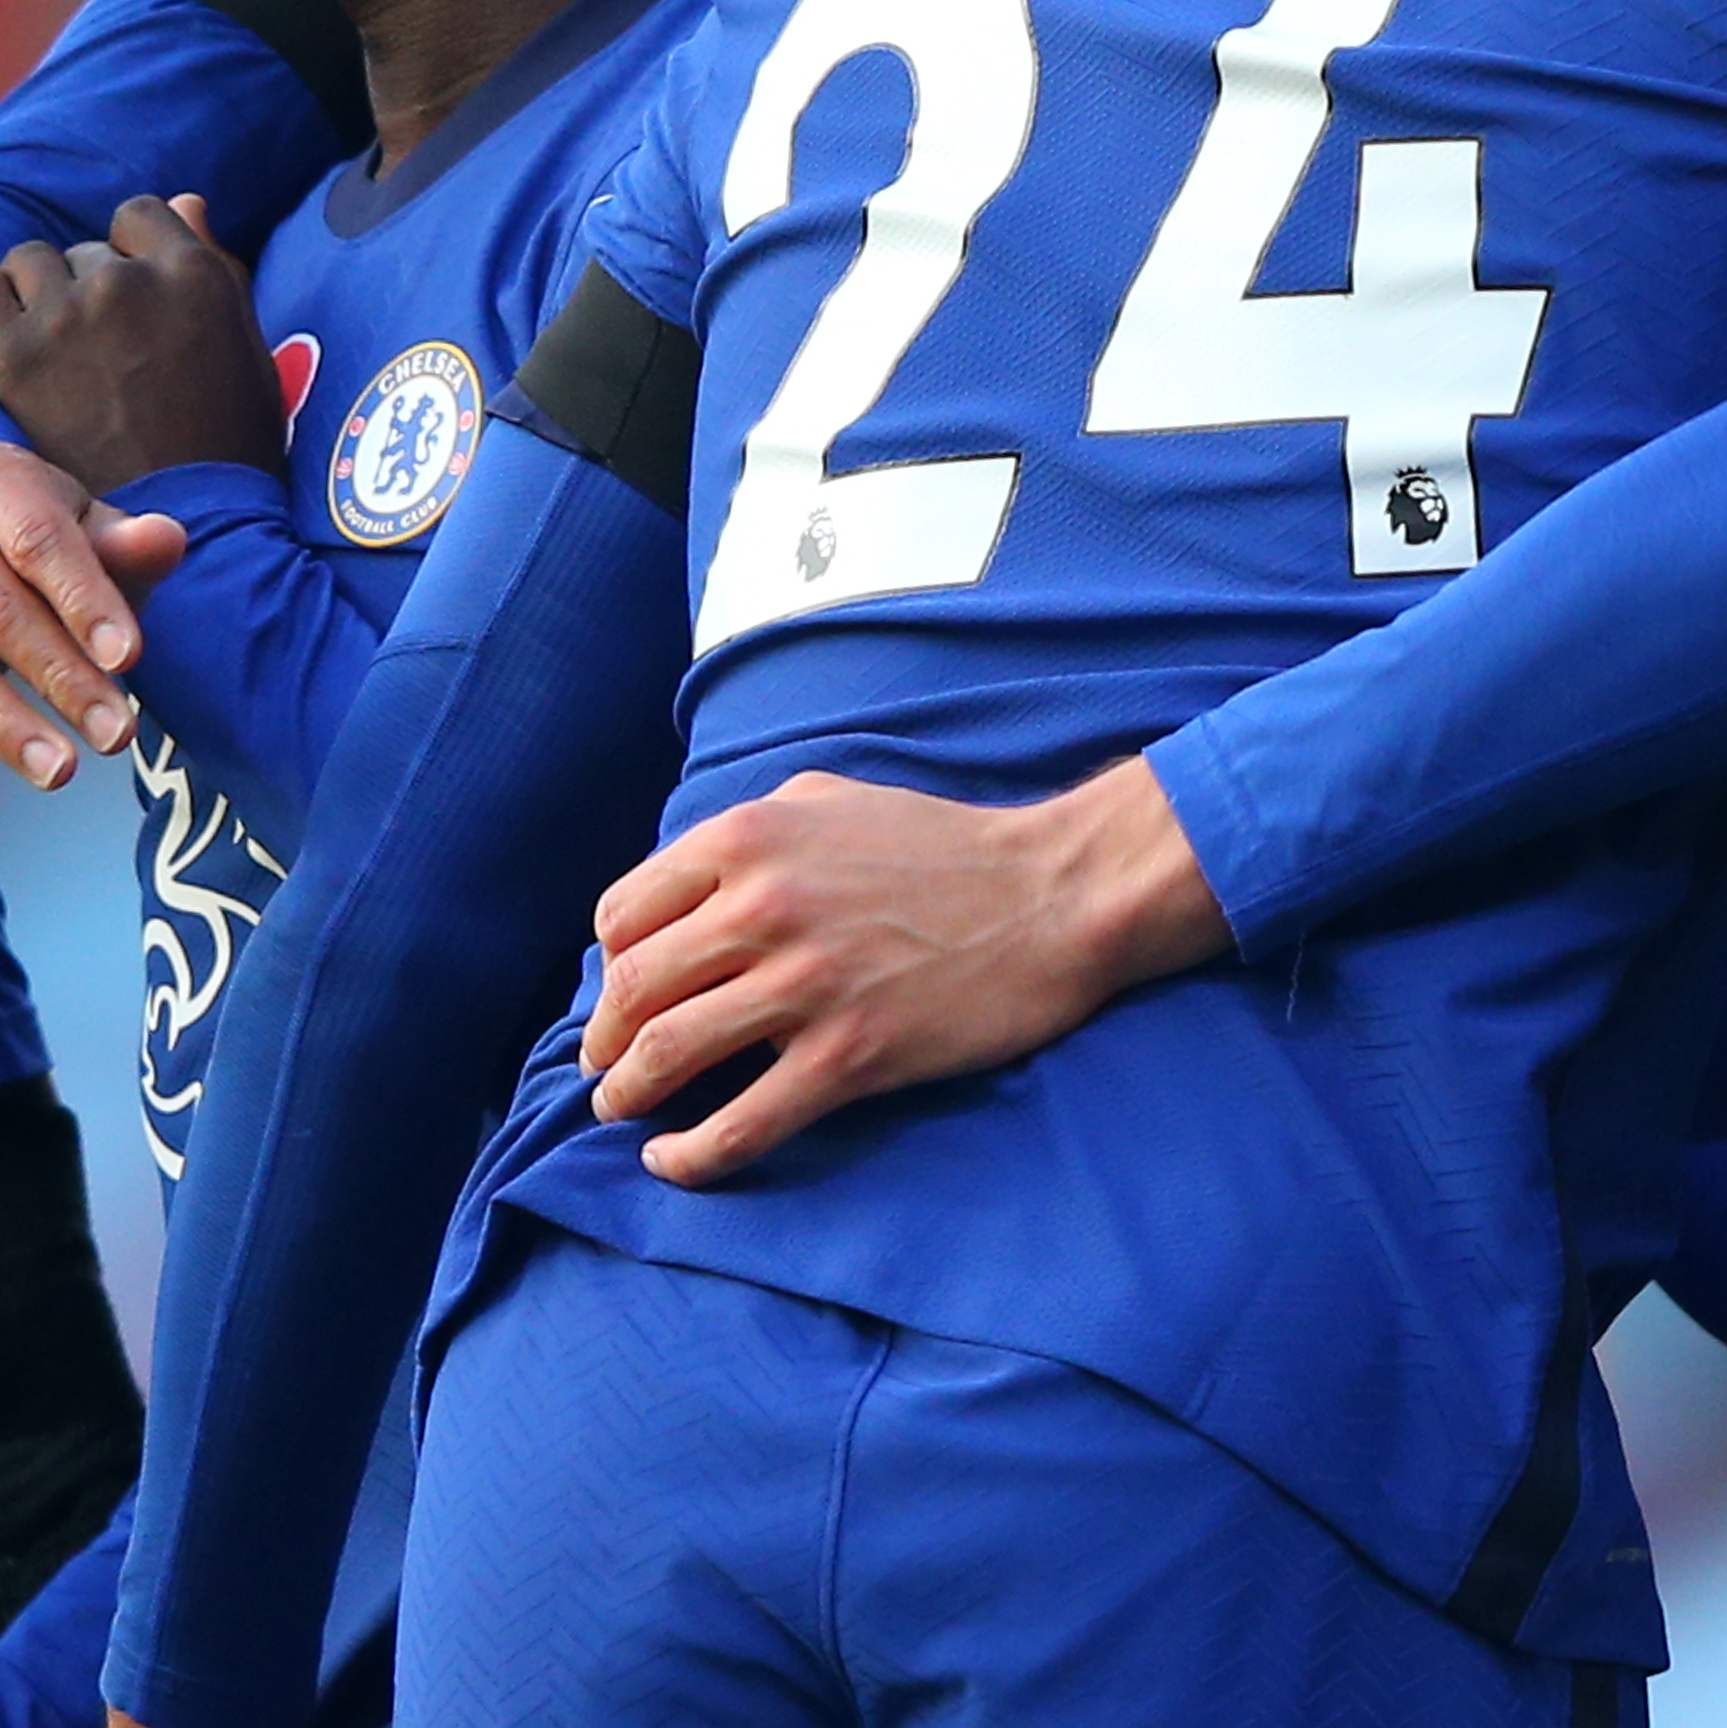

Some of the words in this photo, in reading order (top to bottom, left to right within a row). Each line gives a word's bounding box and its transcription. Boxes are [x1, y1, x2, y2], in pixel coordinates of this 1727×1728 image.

[377, 350, 468, 395] CHELSEA
[340, 498, 394, 534] FOOTBALL
[400, 496, 437, 528] CLUB
